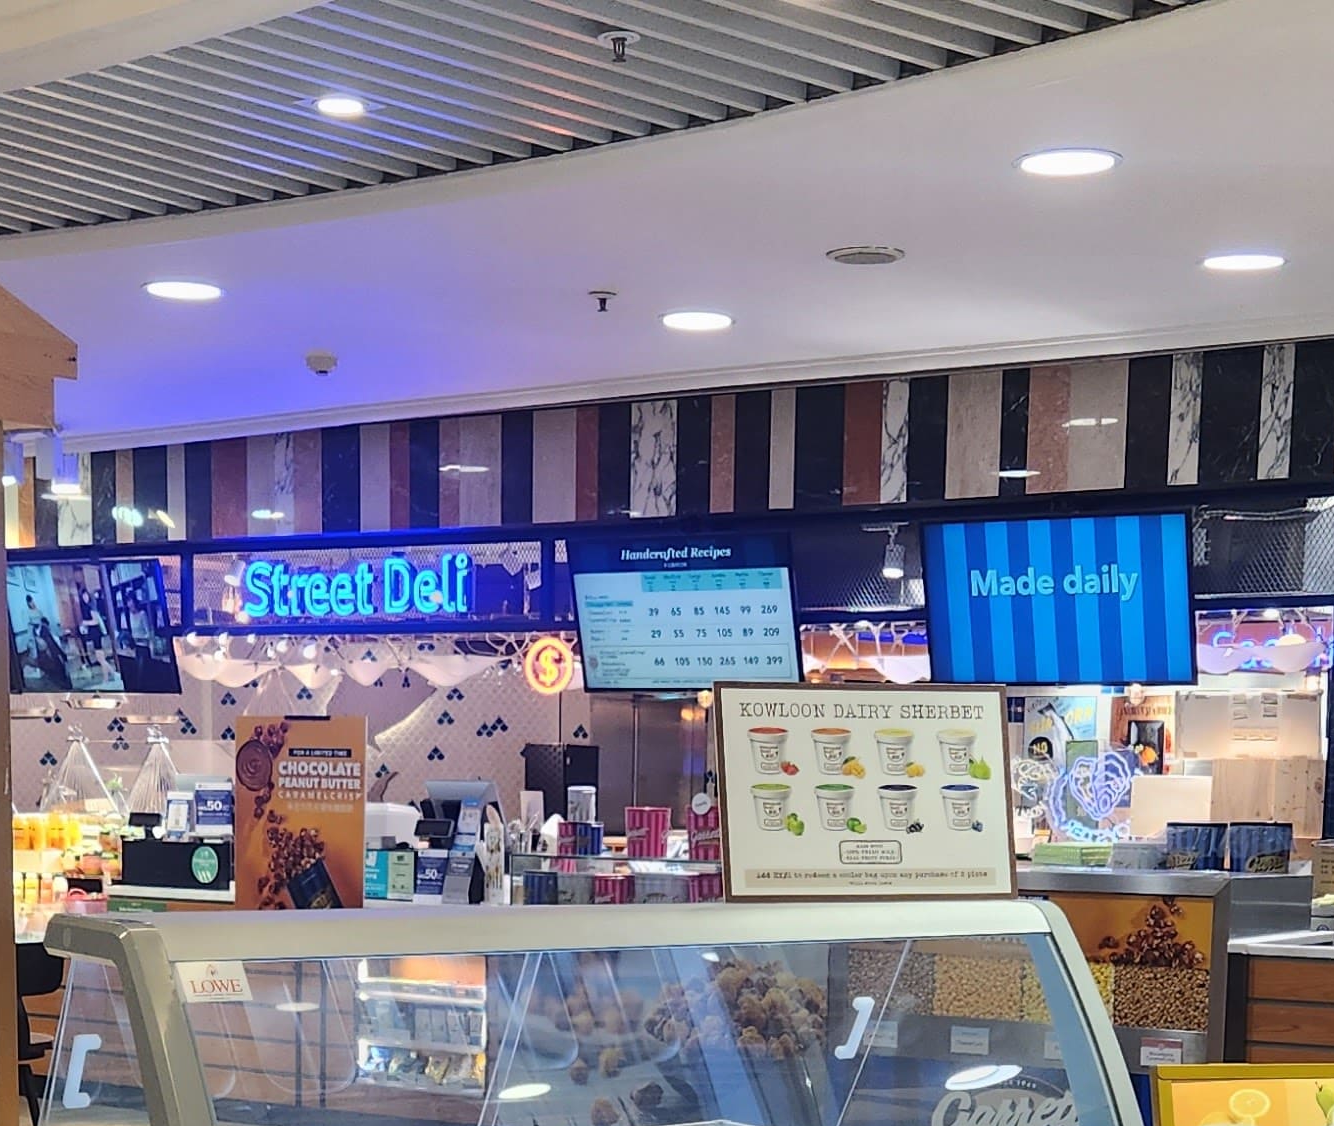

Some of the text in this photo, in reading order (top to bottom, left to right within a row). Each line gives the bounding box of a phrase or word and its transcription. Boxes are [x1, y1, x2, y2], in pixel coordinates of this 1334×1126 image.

[621, 545, 731, 561] Handcrafted Recipes
[241, 551, 469, 619] Street Deli
[970, 564, 1139, 600] Made daily
[671, 607, 682, 616] 65
[714, 606, 730, 615] 145
[761, 605, 778, 614] 269
[717, 628, 732, 637] 105
[763, 628, 779, 637] 209
[739, 702, 985, 720] KOWLOON DAIRY SHERBET
[278, 761, 361, 777] CHOCOLATE
[278, 777, 361, 790] PEANUT BUTTER
[190, 979, 243, 993] LOWE
